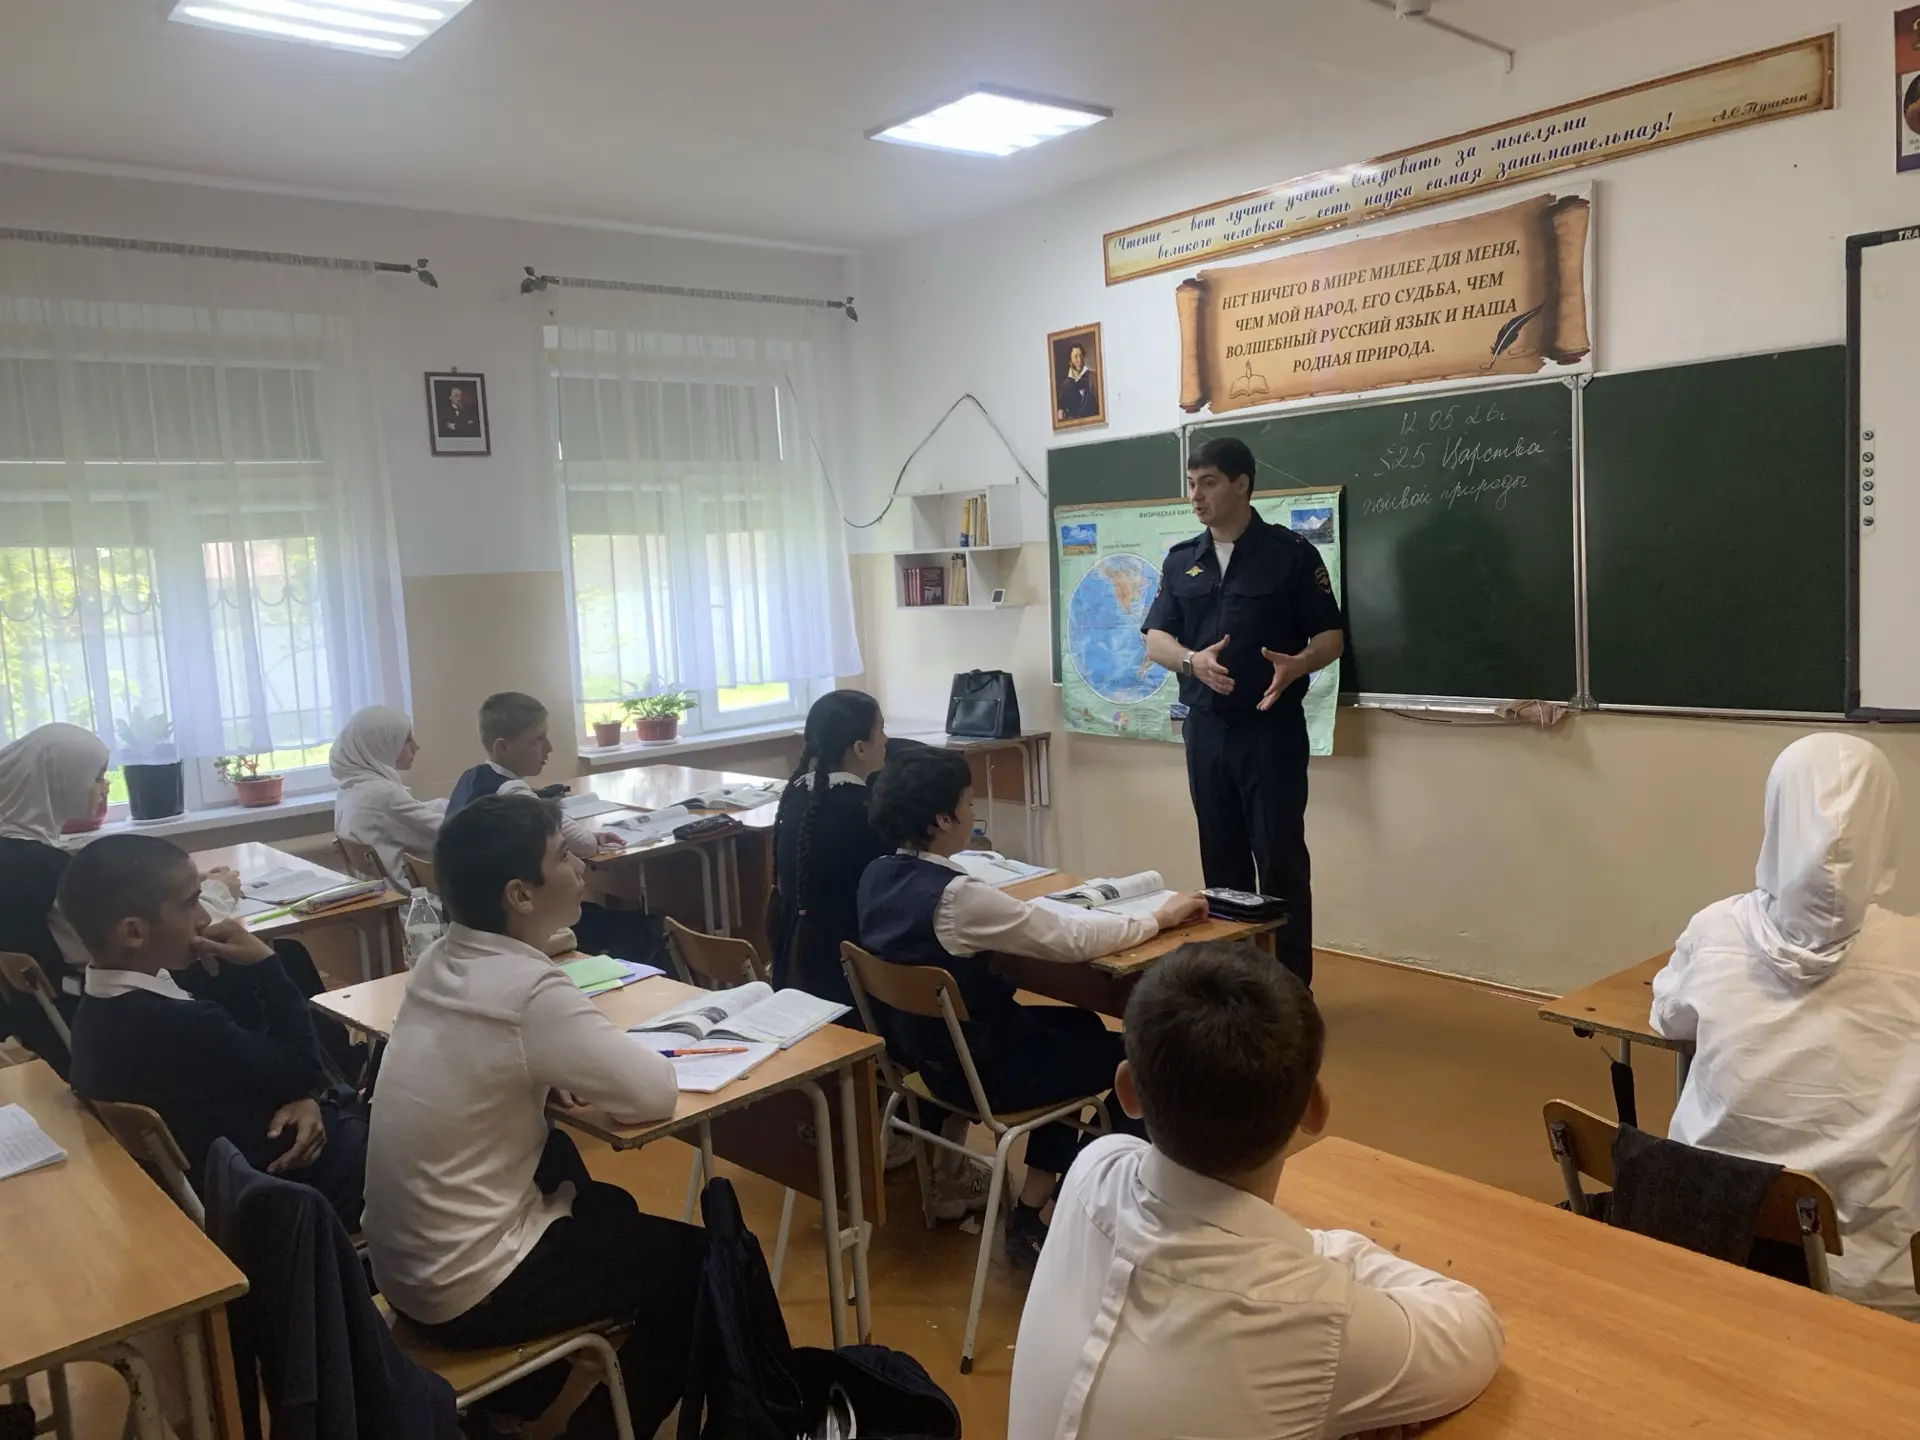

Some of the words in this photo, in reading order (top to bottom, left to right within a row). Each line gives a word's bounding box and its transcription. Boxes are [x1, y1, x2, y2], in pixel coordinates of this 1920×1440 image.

[1114, 231, 1162, 251] Чтение
[1190, 215, 1216, 232] вот
[1225, 200, 1275, 225] лучшее
[1285, 184, 1340, 212] учение.
[1351, 157, 1441, 189] Следовать
[1455, 144, 1477, 167] за
[1491, 115, 1588, 152] мыслями
[1157, 235, 1212, 260] великого
[1223, 217, 1284, 242] человека
[1317, 202, 1352, 219] есть
[1364, 184, 1413, 208] наука
[1426, 166, 1484, 191] самая
[1496, 112, 1674, 179] занимательная!
[1222, 293, 1249, 310] НЕТ
[1251, 281, 1307, 305] НИЧЕГО
[1311, 279, 1320, 293] В
[1323, 268, 1367, 291] МИРЕ
[1369, 258, 1426, 283] МИЛЕЕ
[1427, 250, 1462, 273] ДЛЯ
[1465, 239, 1520, 263] МЕНЯ,
[1235, 316, 1263, 332] ЧЕМ
[1267, 306, 1300, 327] МОЙ
[1303, 298, 1358, 320] НАРОД,
[1362, 291, 1391, 310] ЕГО
[1395, 280, 1461, 304] СУДЬБА,
[1466, 271, 1504, 291] ЧЕМ
[1225, 328, 1317, 359] ВОЛШЕБНЫЙ
[1320, 316, 1391, 343] РУССКИЙ
[1394, 310, 1442, 331] ЯЗЫК
[1444, 308, 1459, 323] И
[1461, 298, 1517, 321] НАША
[1292, 351, 1352, 373] РОДНАЯ
[1356, 340, 1435, 363] ПРИРОДА.
